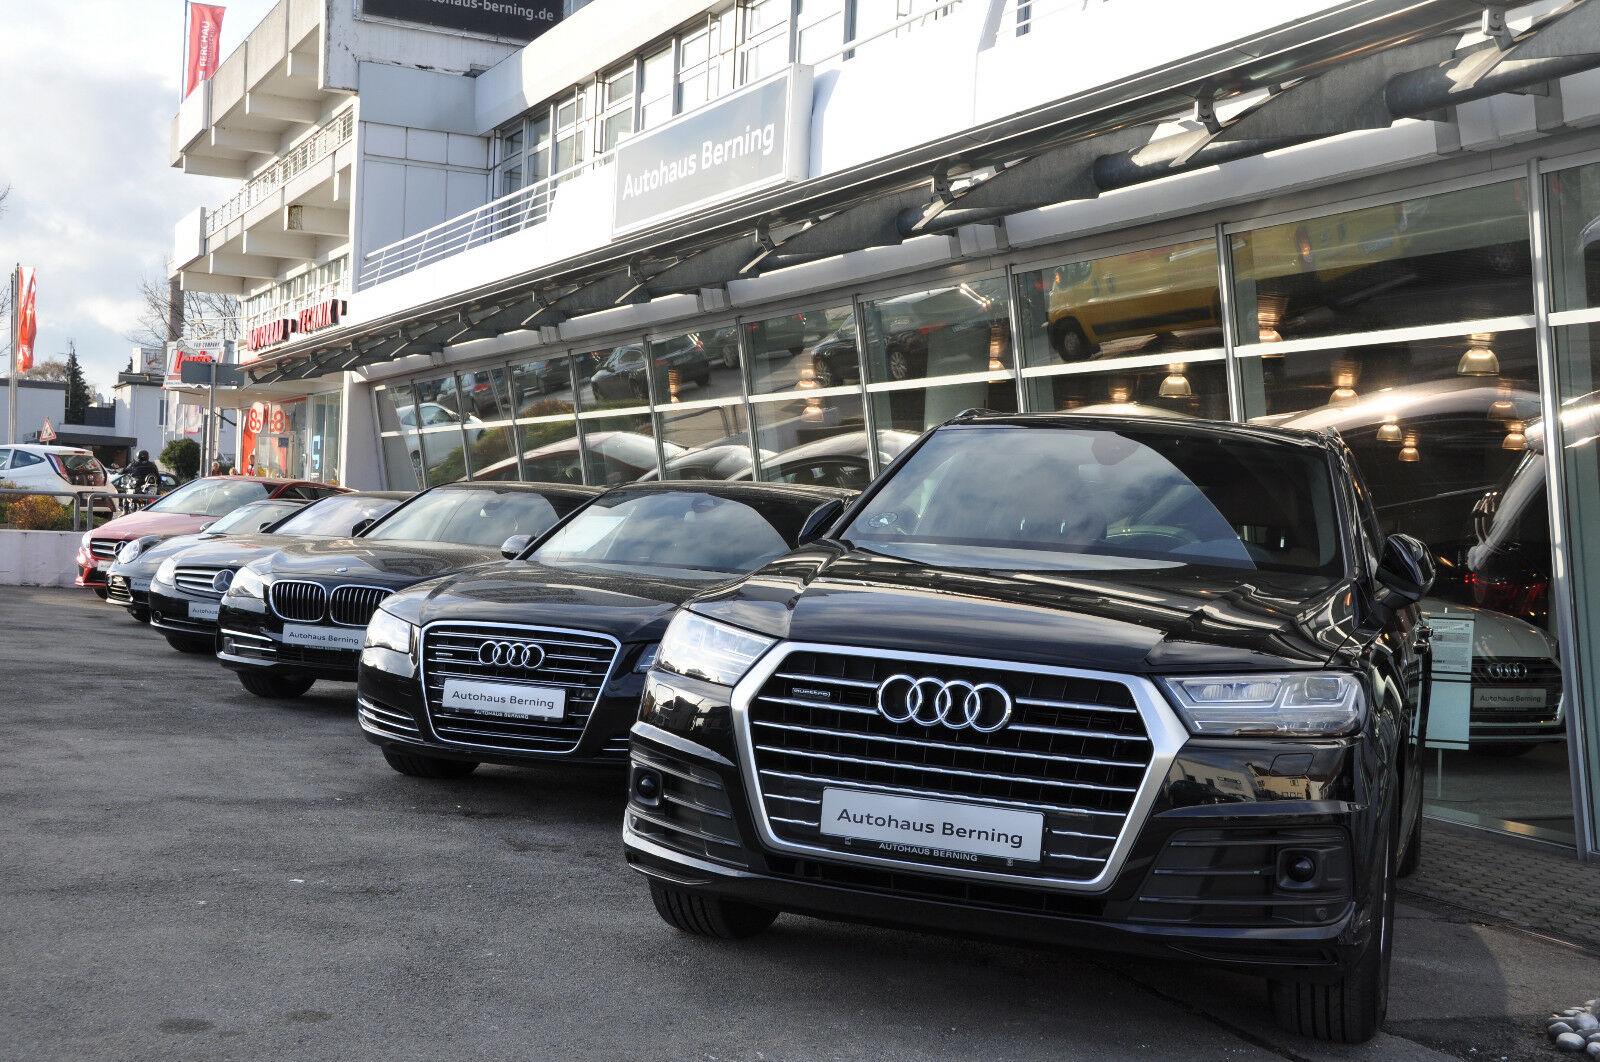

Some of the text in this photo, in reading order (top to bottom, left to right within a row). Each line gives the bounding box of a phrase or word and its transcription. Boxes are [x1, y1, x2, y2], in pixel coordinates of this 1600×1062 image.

[199, 20, 210, 67] FERCHAU
[622, 122, 775, 201] Autohaus Berning
[289, 631, 359, 645] Autohaus Berning
[452, 690, 555, 710] Autohaus Berning
[836, 807, 1024, 849] Autohaus Berning
[879, 842, 978, 862] AUTOHAUS BERNING
